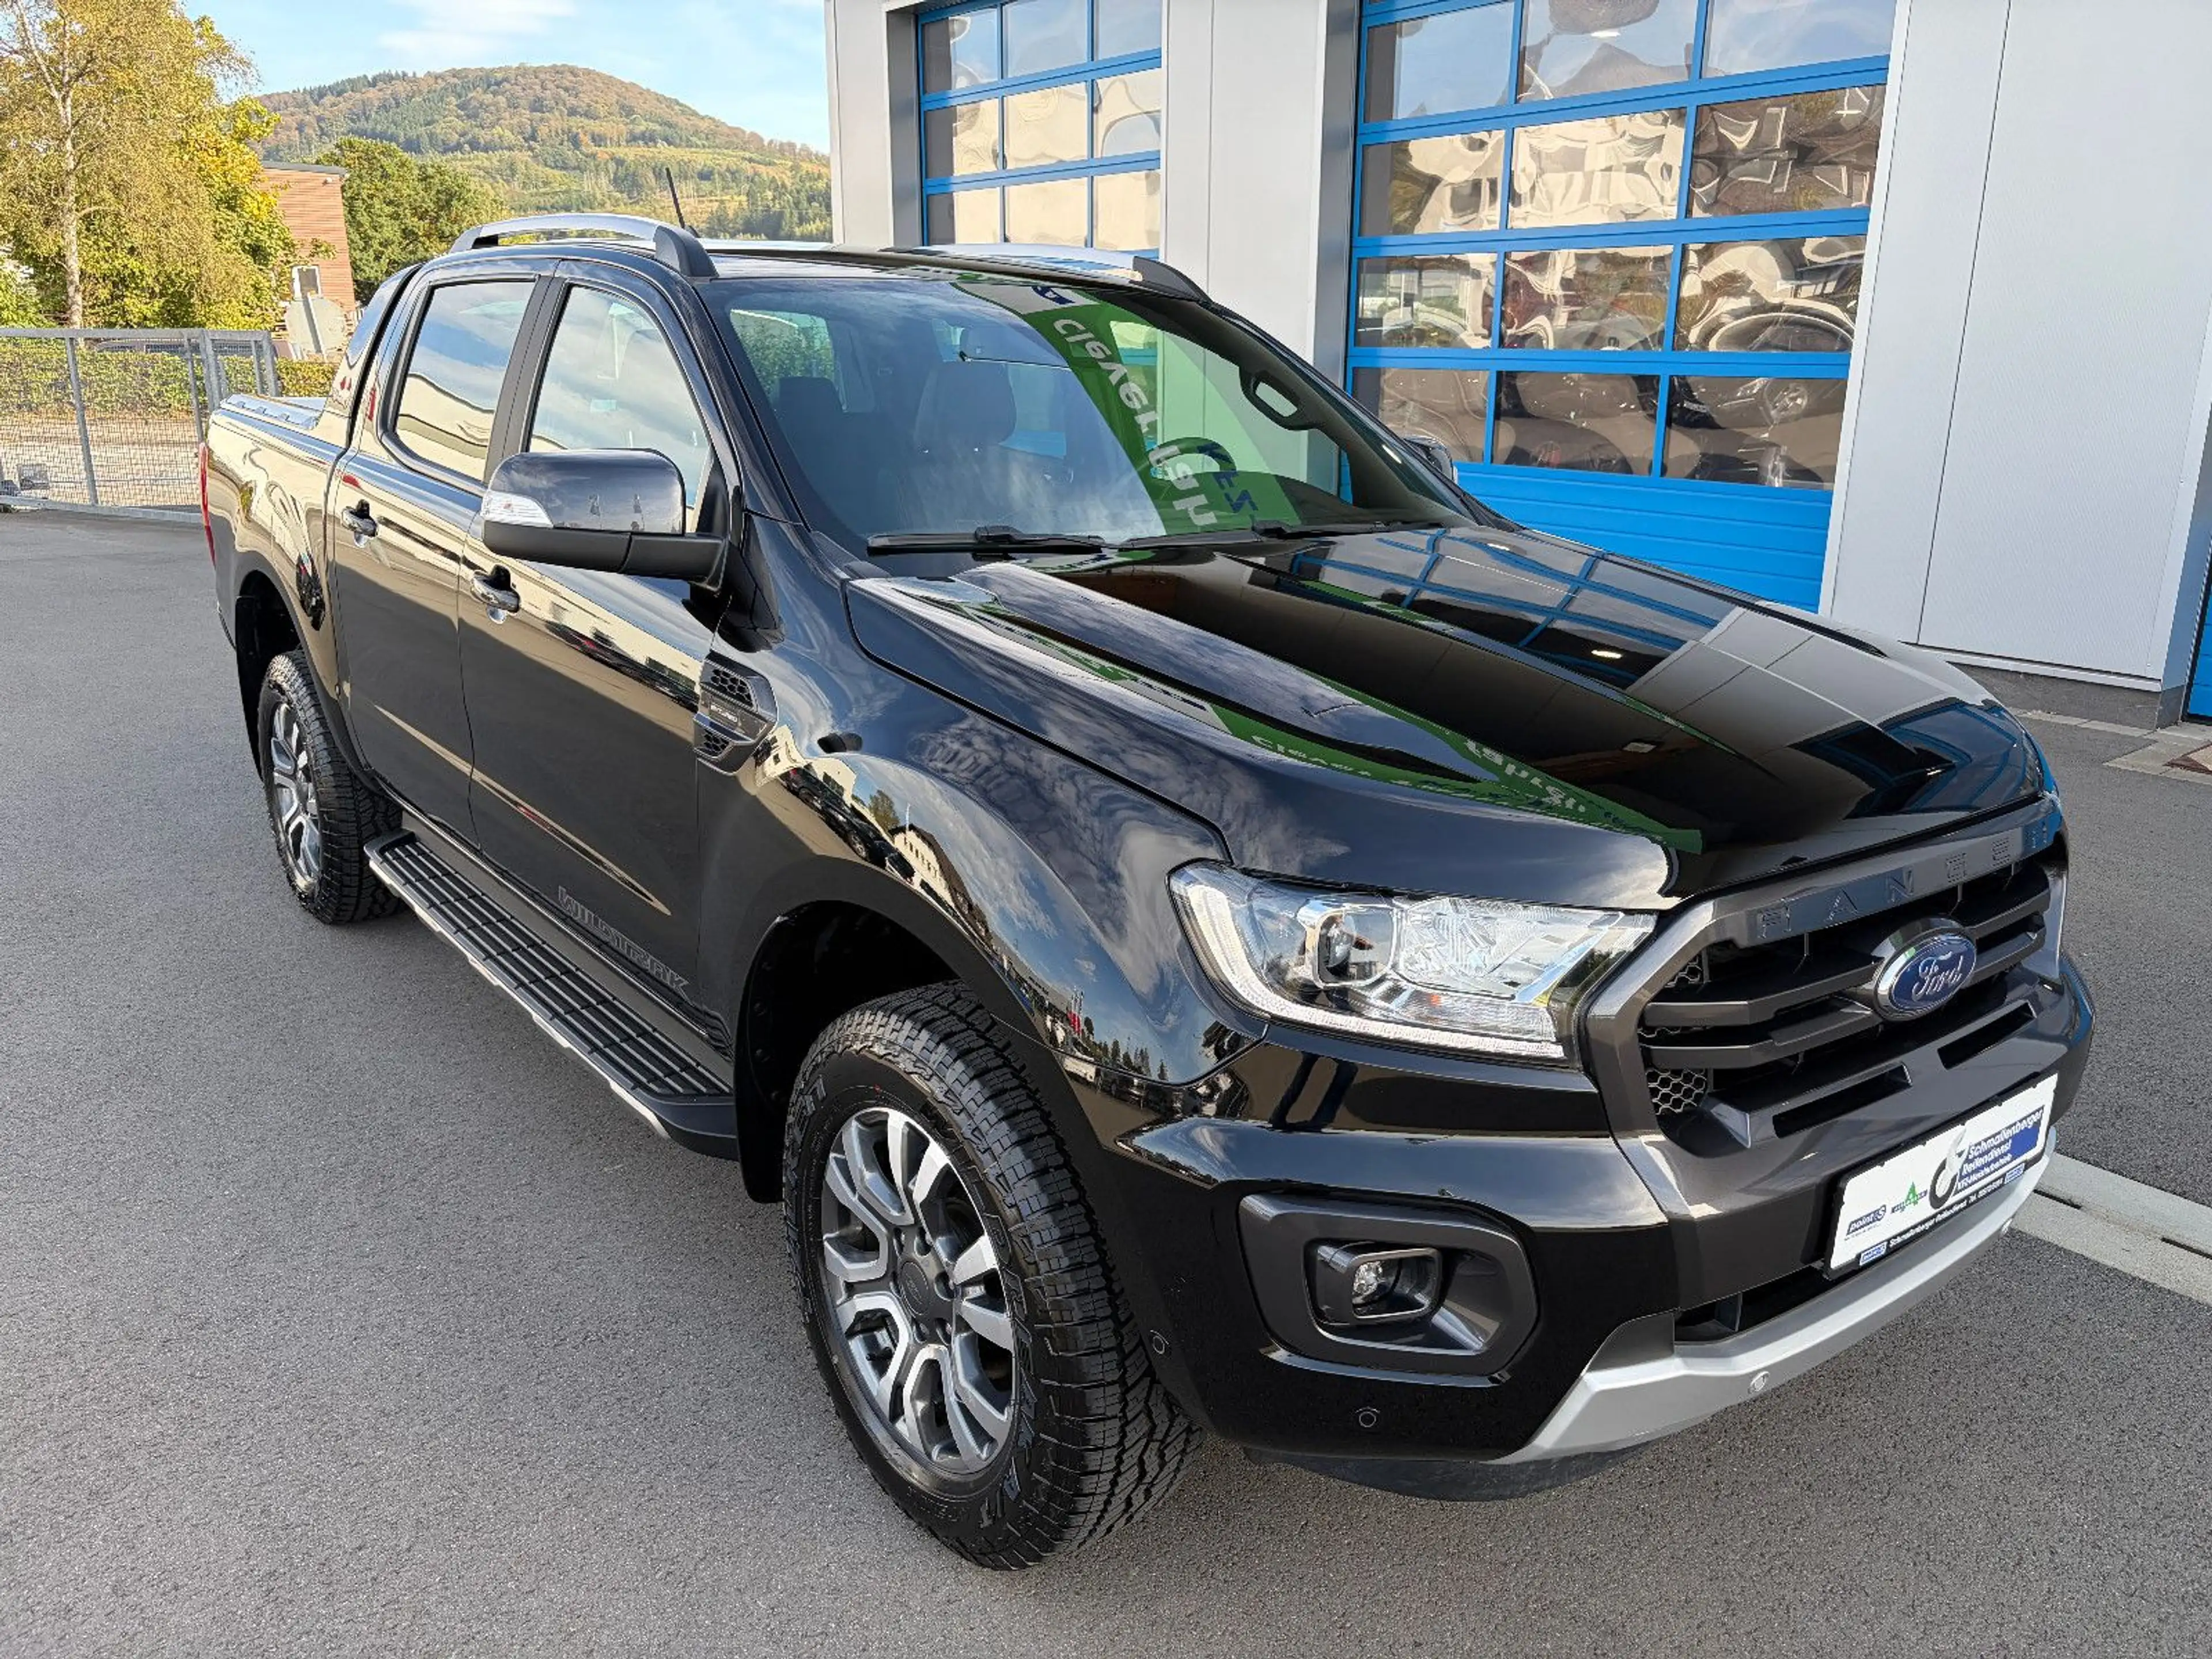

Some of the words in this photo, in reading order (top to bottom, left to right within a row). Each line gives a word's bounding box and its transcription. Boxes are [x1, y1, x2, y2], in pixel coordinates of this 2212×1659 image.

[1757, 816, 2048, 939] RANGER
[558, 885, 692, 1006] WILDTRAK
[1911, 950, 1964, 1002] Ford
